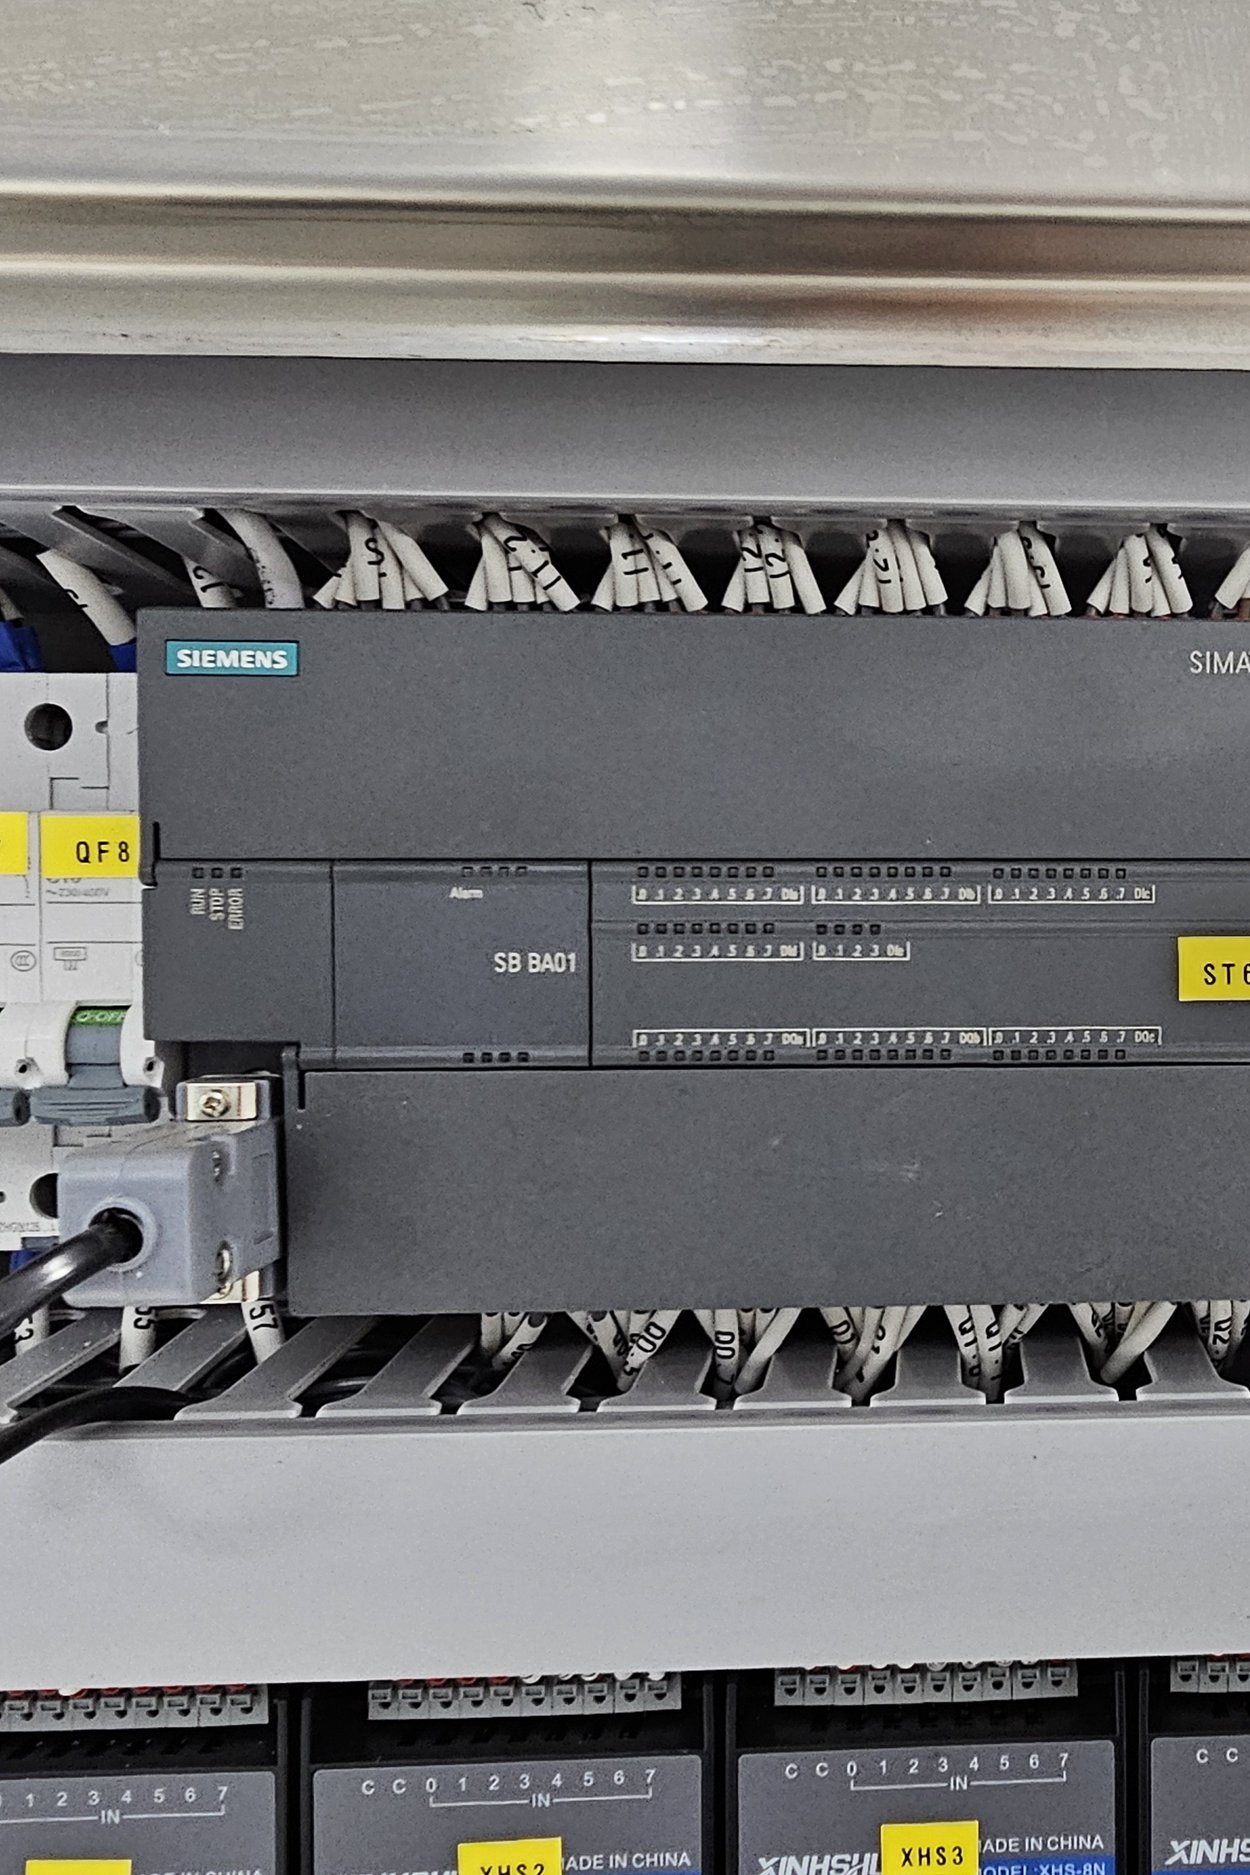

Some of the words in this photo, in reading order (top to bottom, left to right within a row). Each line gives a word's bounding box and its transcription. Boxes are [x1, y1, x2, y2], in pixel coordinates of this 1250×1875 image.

[178, 650, 287, 668] SIEMENS
[76, 841, 129, 863] QF8
[209, 888, 225, 921] STOP
[228, 888, 244, 930] ERROR
[495, 953, 521, 972] SB
[528, 953, 575, 972] BA01
[847, 1761, 856, 1776] 0
[880, 1760, 886, 1774] 1
[909, 1759, 918, 1773] 2
[939, 1757, 948, 1772] 3
[970, 1757, 978, 1771] 4
[1000, 1755, 1009, 1770] 5
[1030, 1754, 1039, 1768] 6
[1060, 1753, 1068, 1767] 7
[426, 1778, 437, 1792] 0
[459, 1777, 466, 1791] 1
[489, 1775, 499, 1790] 2
[520, 1774, 530, 1789] 3
[552, 1773, 562, 1787] 4
[584, 1772, 593, 1786] 5
[614, 1770, 624, 1784] 6
[646, 1769, 655, 1783] 7
[951, 1776, 967, 1790] IN
[26, 1793, 33, 1807] 1
[57, 1792, 67, 1806] 2
[89, 1791, 99, 1805] 3
[121, 1790, 131, 1803] 4
[154, 1788, 165, 1803] 5
[185, 1787, 196, 1802] 6
[218, 1786, 227, 1800] 7
[532, 1793, 550, 1807] IN
[101, 1809, 120, 1824] IN
[979, 1838, 1019, 1854] ADE
[1026, 1838, 1043, 1851] IN
[1048, 1835, 1104, 1850] CHINA
[562, 1855, 603, 1871] ADE
[609, 1855, 627, 1869] IN
[632, 1852, 691, 1868] CHINA
[902, 1846, 963, 1866] XHS3
